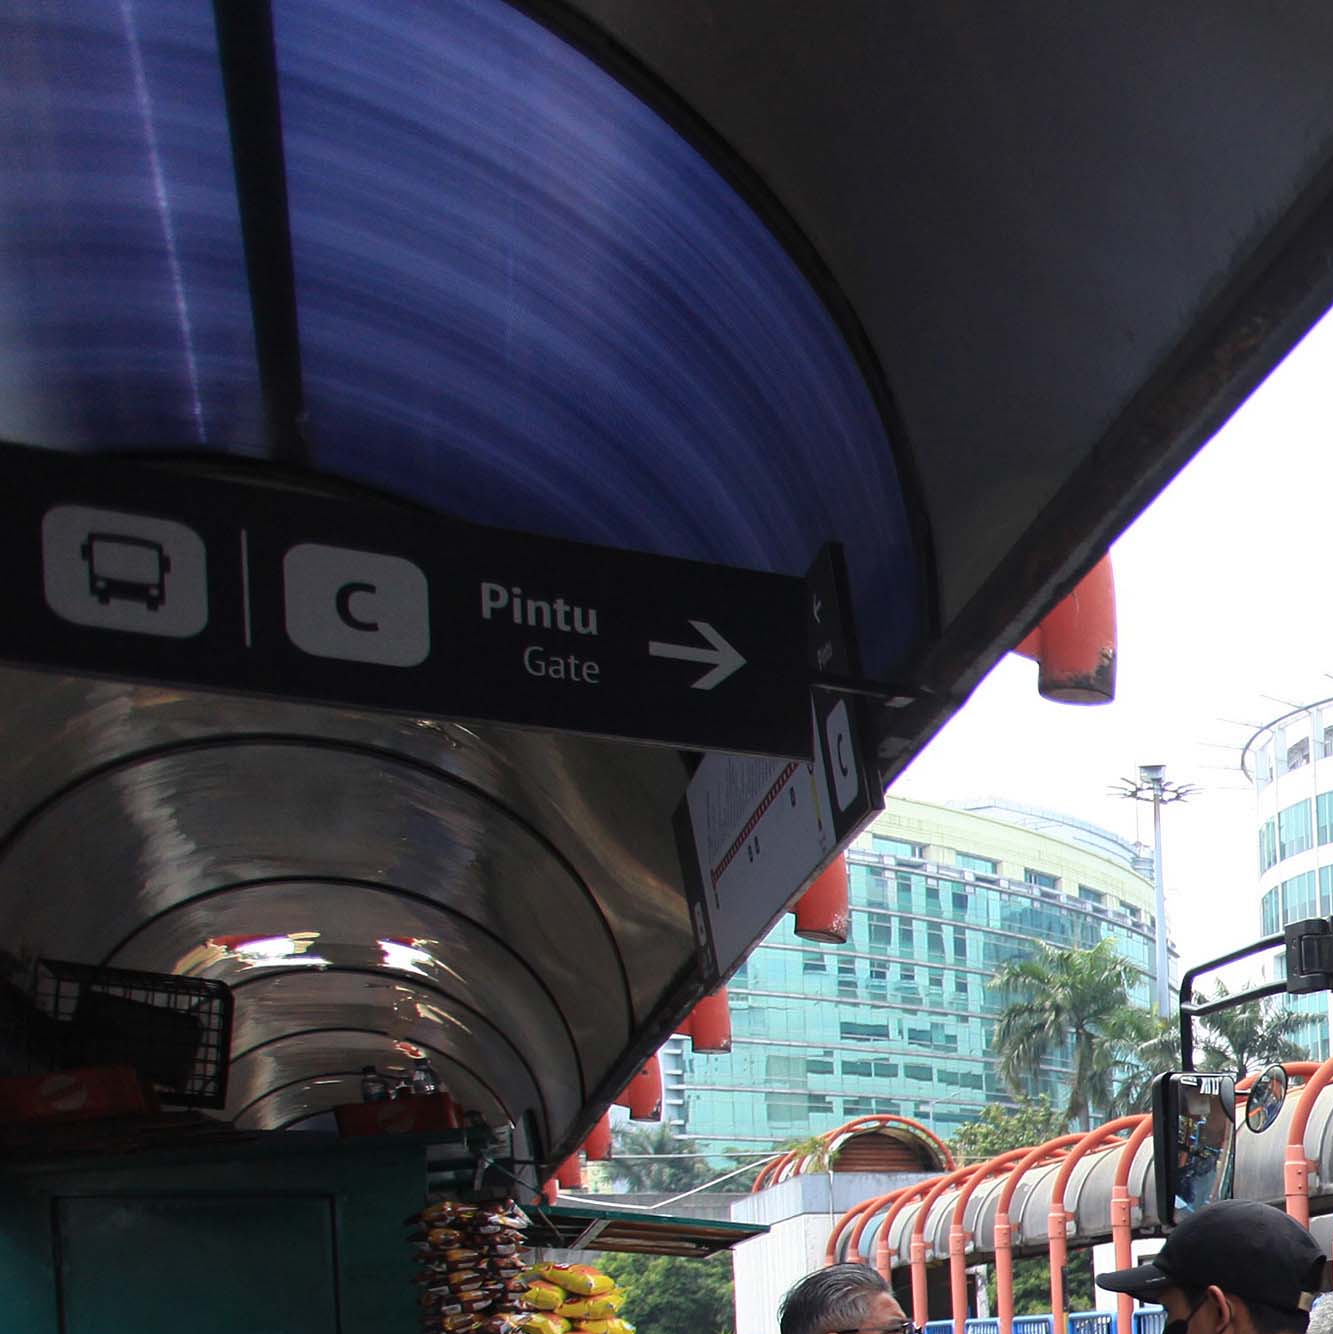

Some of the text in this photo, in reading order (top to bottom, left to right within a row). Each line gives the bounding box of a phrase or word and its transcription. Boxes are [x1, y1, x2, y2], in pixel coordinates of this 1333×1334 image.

[335, 582, 379, 632] C
[480, 581, 599, 636] Pintu
[523, 645, 600, 684] Gate
